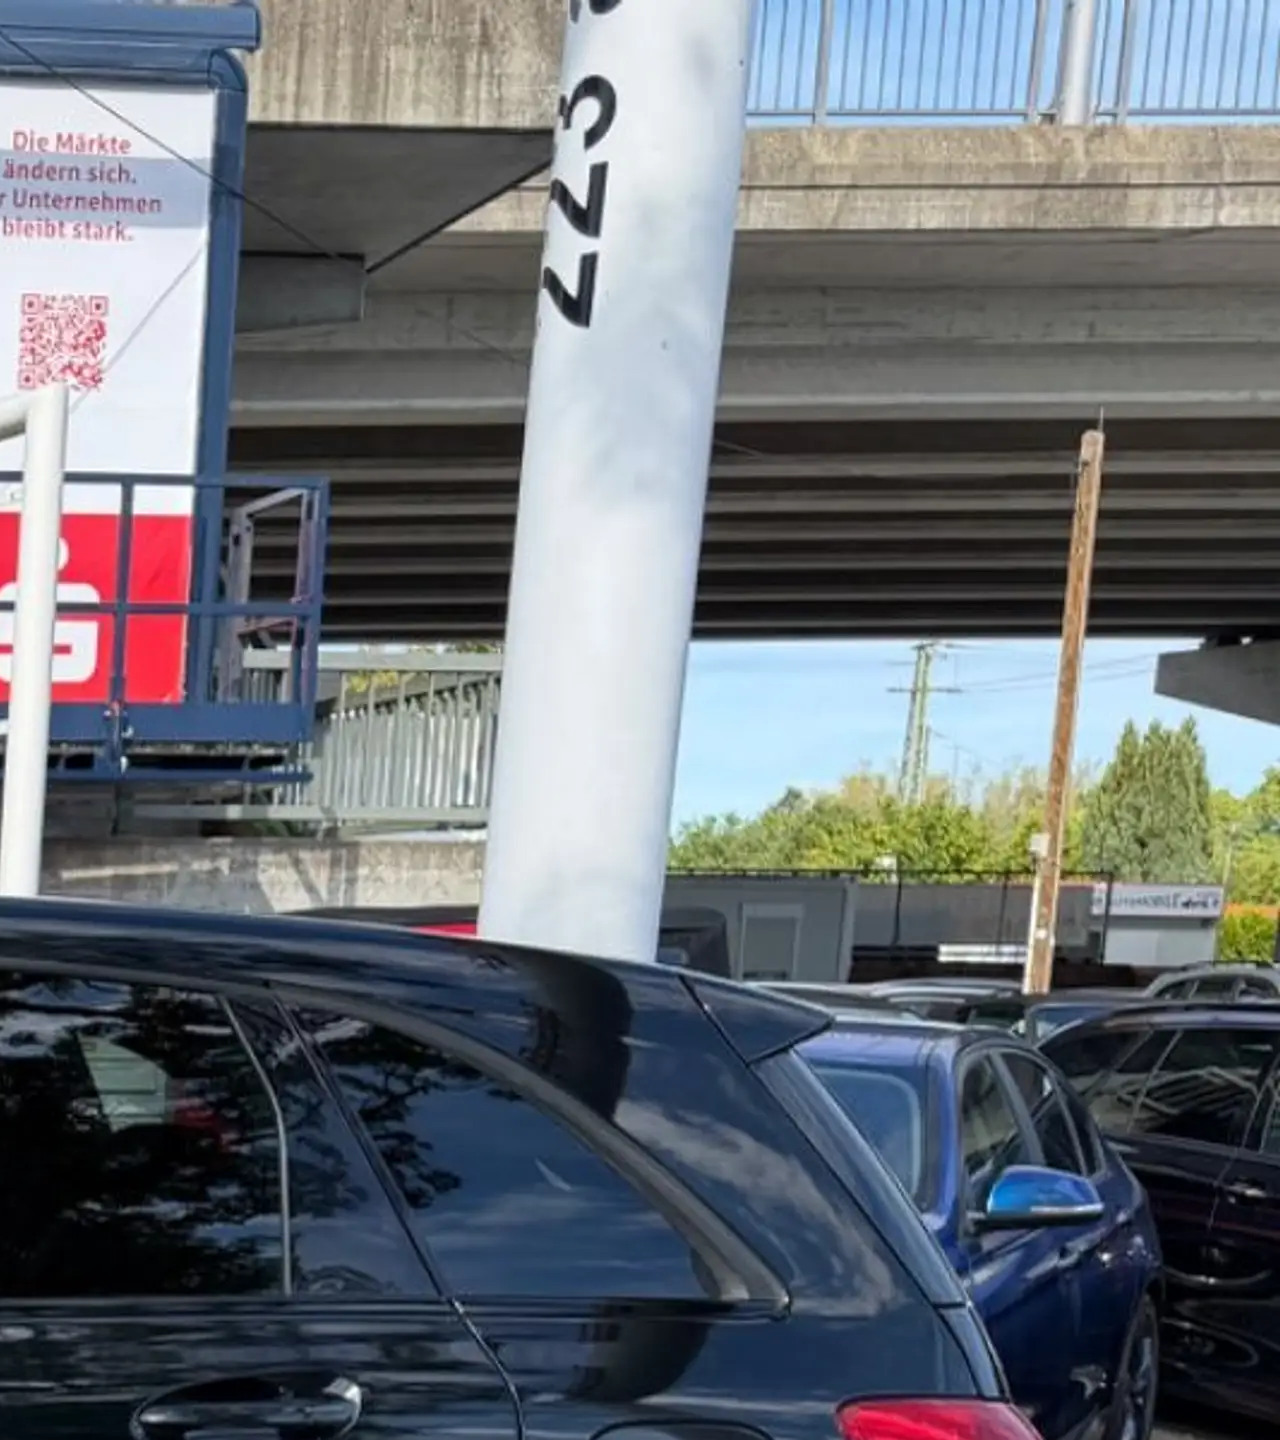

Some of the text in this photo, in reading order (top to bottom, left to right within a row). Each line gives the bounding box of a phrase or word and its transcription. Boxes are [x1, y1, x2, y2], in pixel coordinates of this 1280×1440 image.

[12, 130, 132, 155] Die Märkte
[2, 159, 137, 184] ändern sich.
[13, 187, 163, 214] Unternehmen
[3, 216, 135, 242] bleibt stark.
